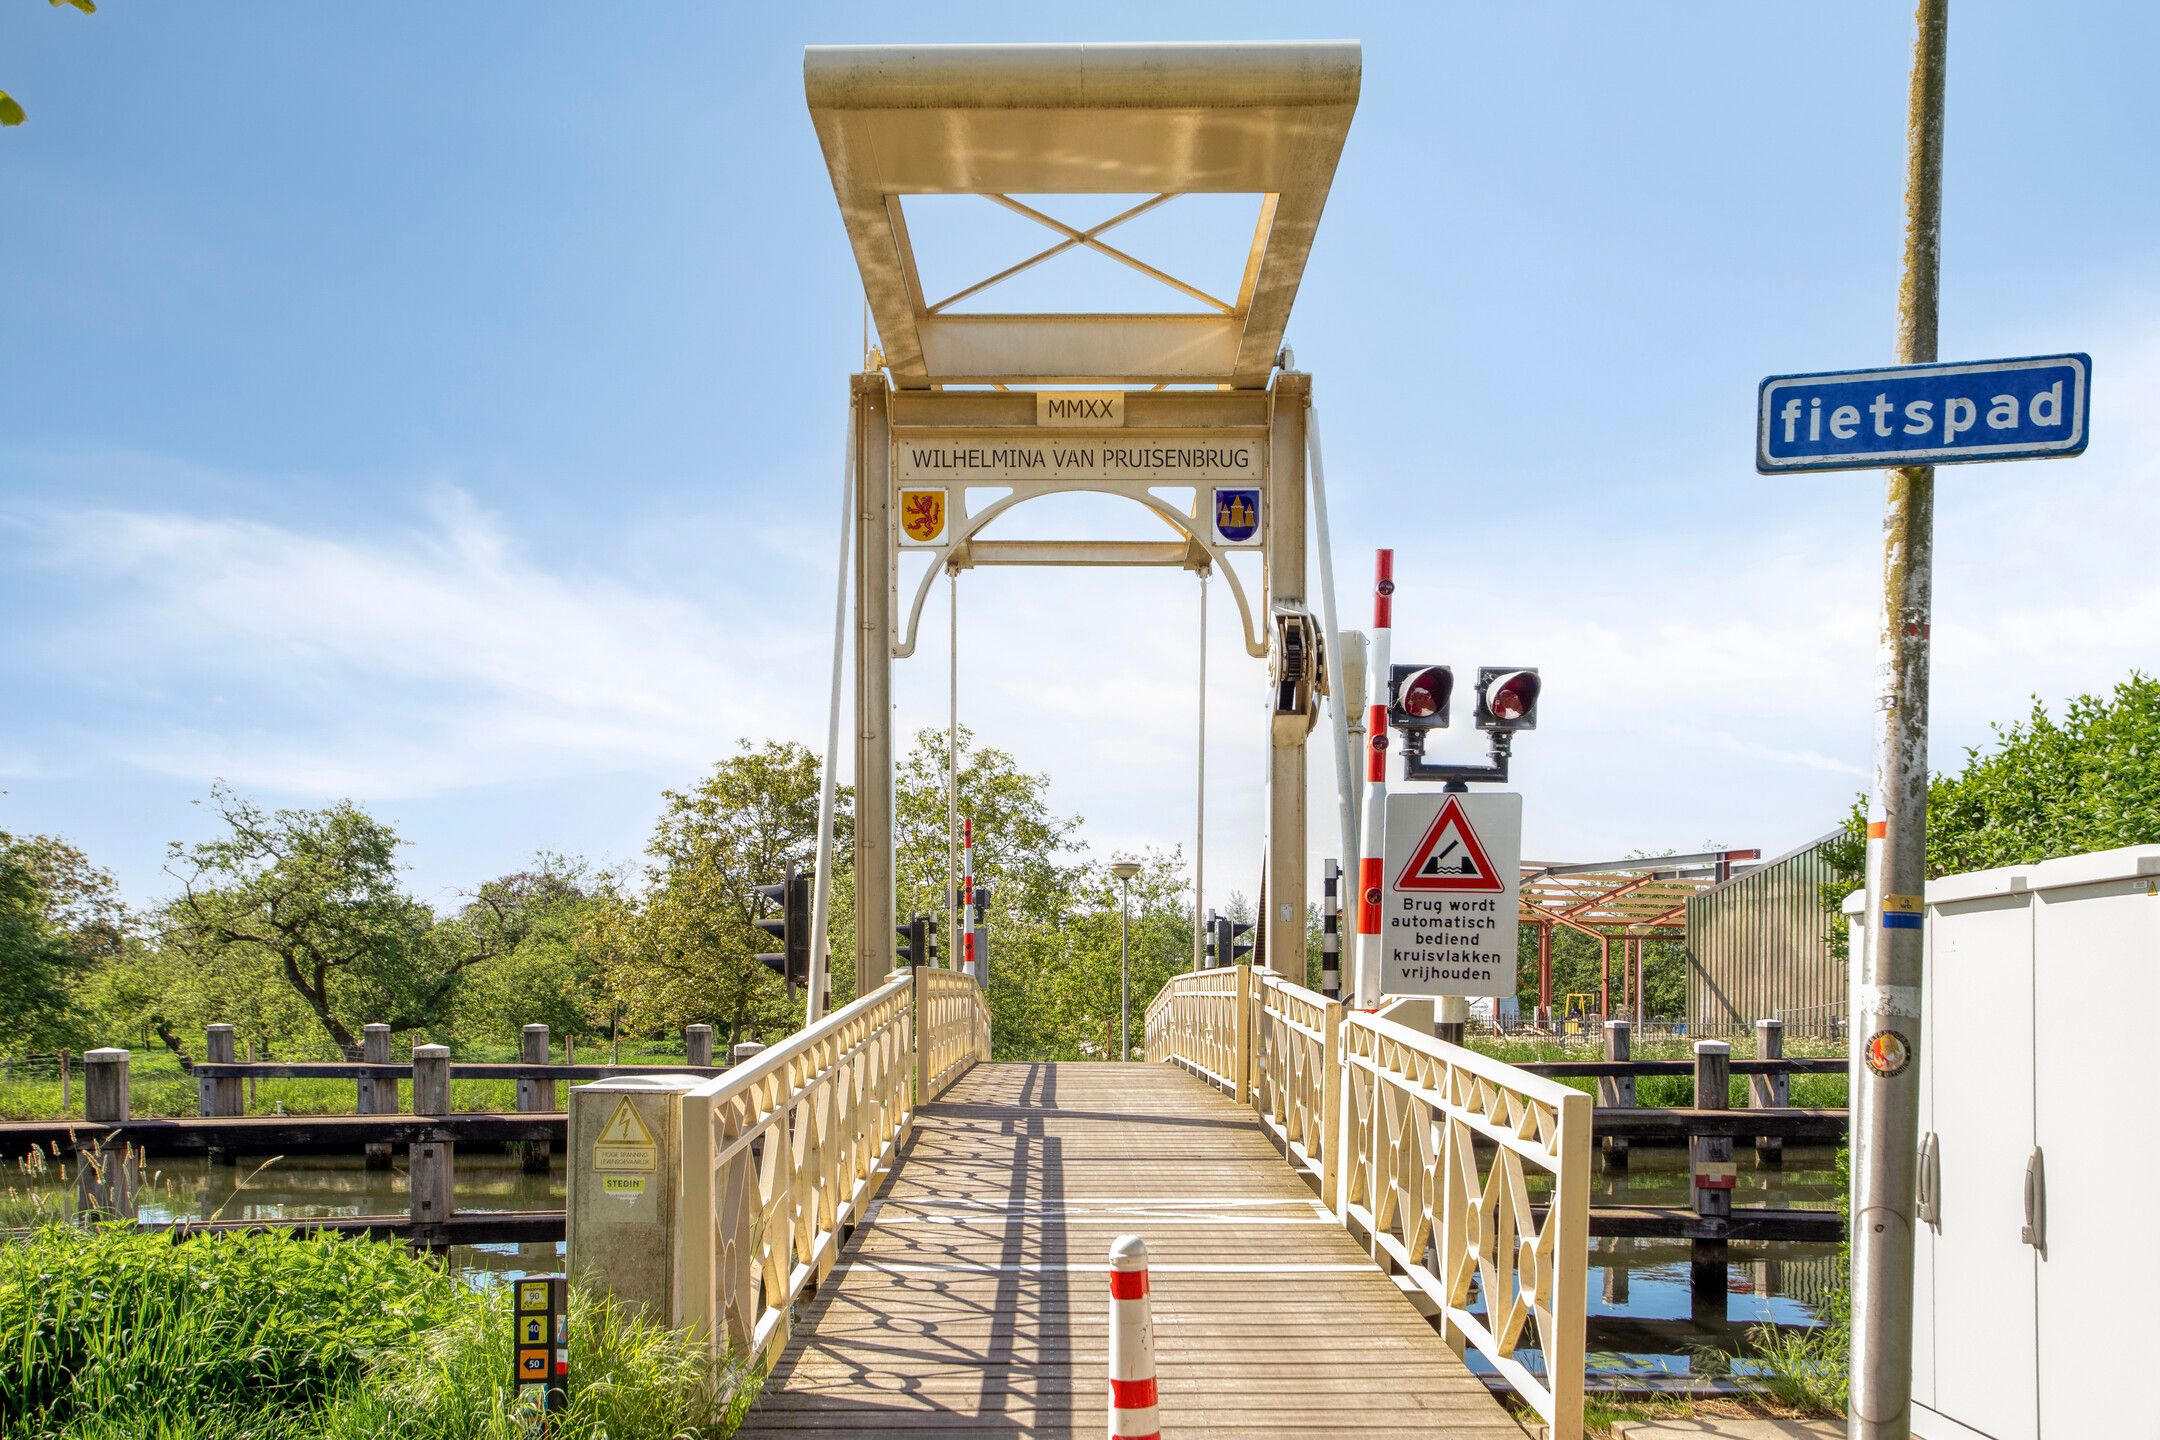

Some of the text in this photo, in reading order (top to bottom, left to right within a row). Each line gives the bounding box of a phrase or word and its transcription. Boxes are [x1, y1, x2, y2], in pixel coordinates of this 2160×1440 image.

[1048, 399, 1114, 419] MMXX
[1780, 379, 2064, 445] fietspad
[912, 449, 1250, 468] WILHELMINA VAN PRUISENBRUG
[1404, 898, 1496, 914] Brug wordt
[1392, 916, 1496, 929] automatisch
[1416, 933, 1479, 945] bediend
[1394, 949, 1501, 963] kruisvlakken
[1402, 966, 1491, 982] vrijhouden
[607, 1180, 639, 1188] STEDIN
[530, 1292, 540, 1300] 90
[529, 1325, 539, 1333] 40
[529, 1360, 540, 1369] 50
